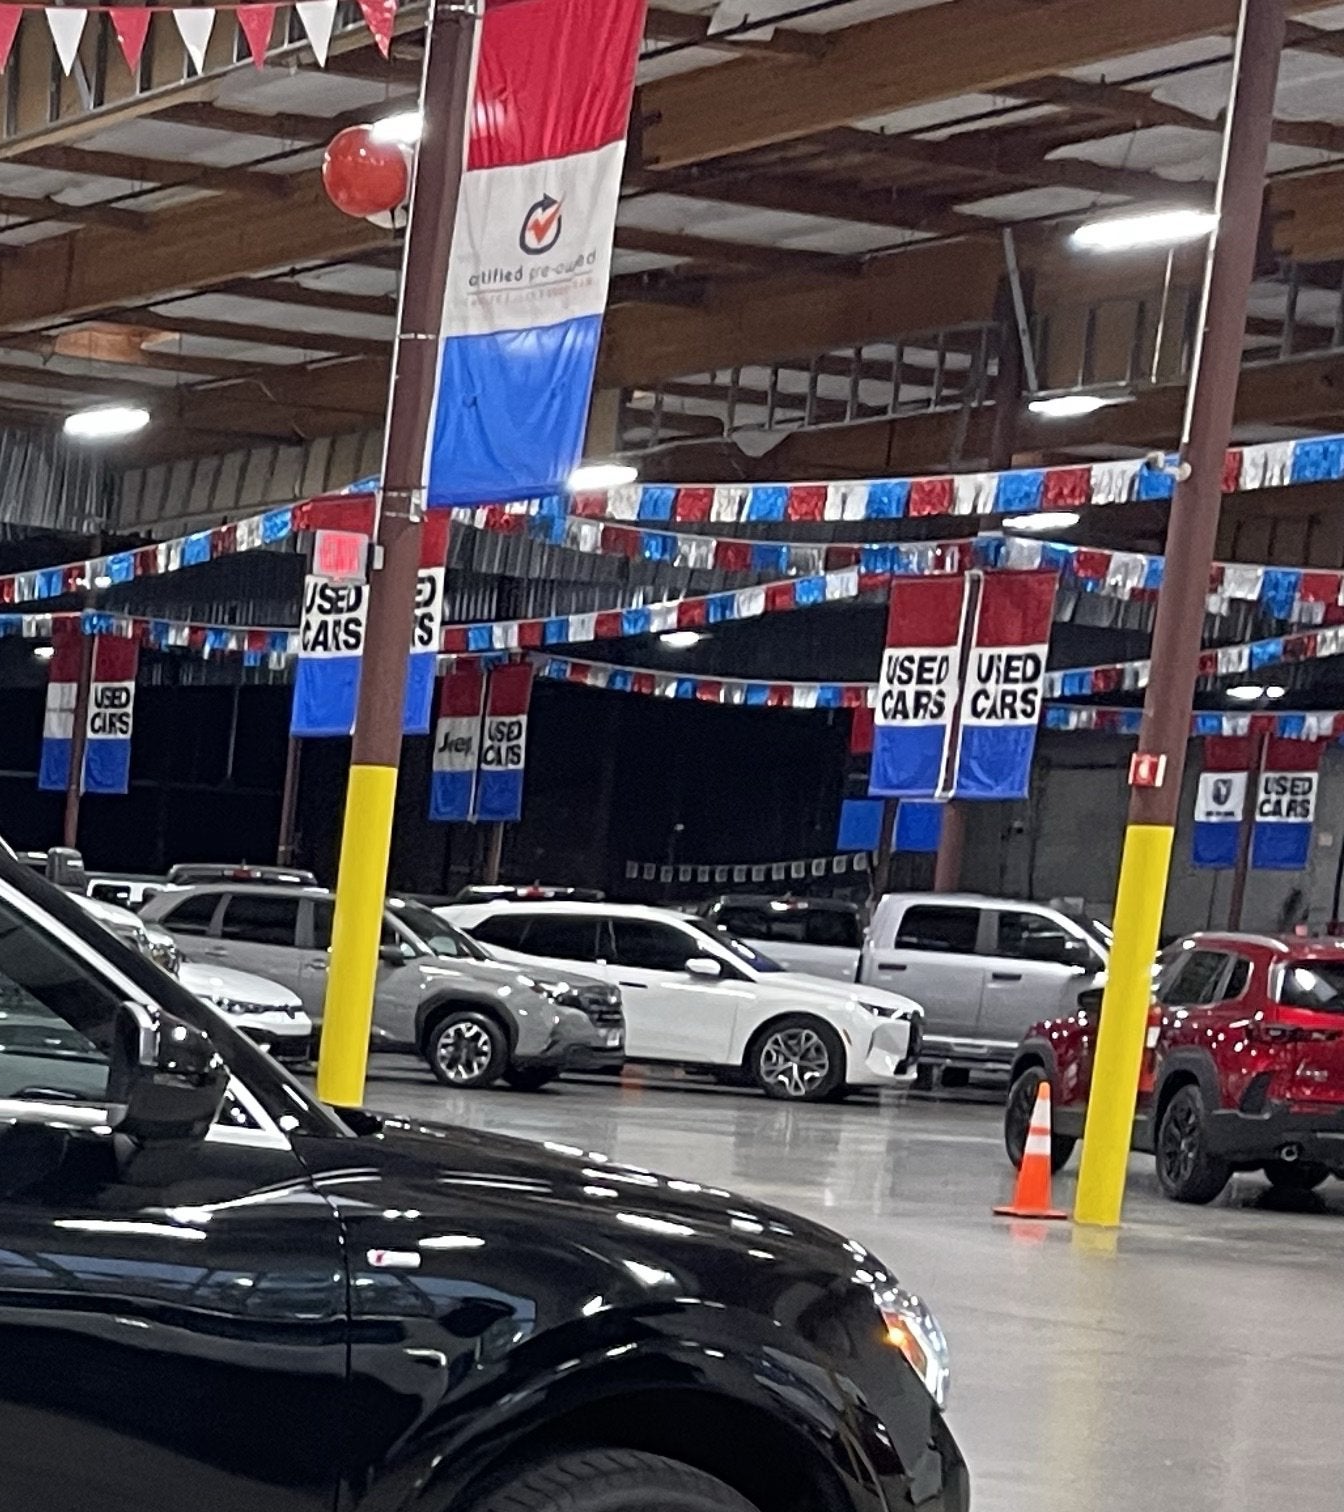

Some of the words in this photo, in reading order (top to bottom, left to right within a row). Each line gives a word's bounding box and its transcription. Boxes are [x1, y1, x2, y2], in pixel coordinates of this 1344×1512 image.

[886, 655, 949, 685] USED
[978, 653, 1042, 684] USED
[94, 686, 130, 709] USED
[882, 689, 945, 720] CARS
[971, 687, 1038, 719] CARS
[1264, 776, 1312, 795] USED
[1259, 799, 1310, 818] CARS
